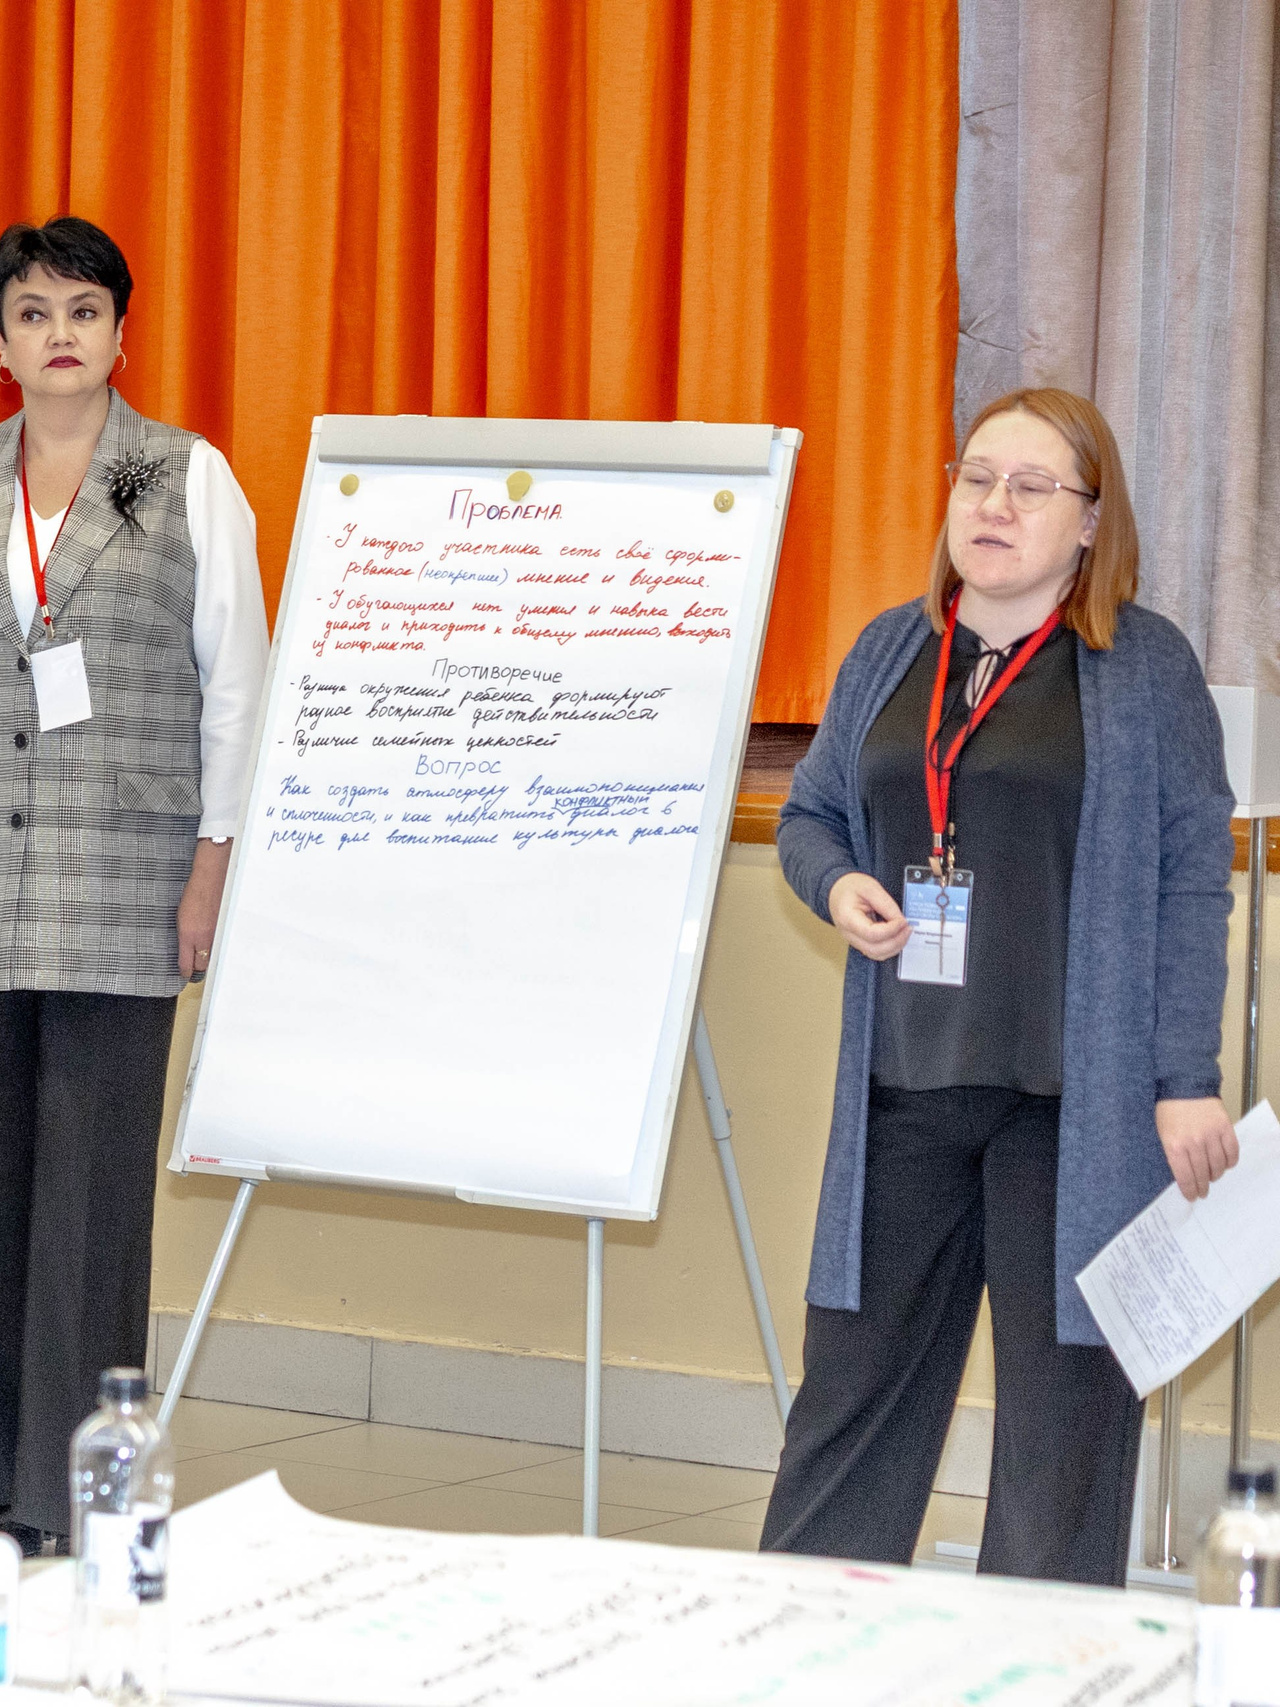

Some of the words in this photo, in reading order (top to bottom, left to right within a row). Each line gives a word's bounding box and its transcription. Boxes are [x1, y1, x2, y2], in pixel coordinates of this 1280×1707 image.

[335, 522, 358, 548] У
[361, 535, 425, 559] каждого
[440, 540, 543, 561] участника
[560, 545, 601, 557] есть
[616, 540, 654, 560] своё
[342, 559, 415, 582] рованное
[516, 572, 590, 584] мнение
[601, 574, 616, 584] и
[328, 589, 345, 610] У
[471, 600, 503, 613] нет
[515, 604, 577, 622] умения
[588, 606, 601, 616] и
[610, 601, 670, 618] навыка
[683, 601, 729, 619] вести
[323, 620, 371, 639] диалог
[381, 622, 391, 632] и
[401, 619, 486, 642] приходить
[494, 627, 503, 635] к
[511, 623, 577, 646] общему
[667, 622, 732, 645] выходить
[312, 639, 327, 657] из
[432, 658, 564, 686] Противоречие
[298, 674, 348, 700] Разница
[359, 682, 451, 704] окружения
[458, 687, 535, 709] ребенка
[548, 687, 673, 709] формируют
[294, 704, 353, 731] разное
[365, 699, 457, 723] восприятие
[472, 706, 659, 729] действительности
[292, 729, 359, 758] Различие
[371, 731, 456, 748] семейных
[466, 732, 561, 753] ценностей
[415, 753, 502, 780] Вопрос
[279, 775, 312, 796] Как
[327, 784, 390, 808] создать
[405, 784, 510, 813] атмосферу
[266, 806, 276, 818] и
[384, 814, 394, 823] и
[401, 811, 432, 823] как
[445, 801, 556, 828] превратить
[567, 805, 650, 827] диалог
[268, 829, 326, 853] ресурс
[337, 831, 370, 851] для
[513, 829, 619, 850] культуры
[628, 824, 700, 845] диалога
